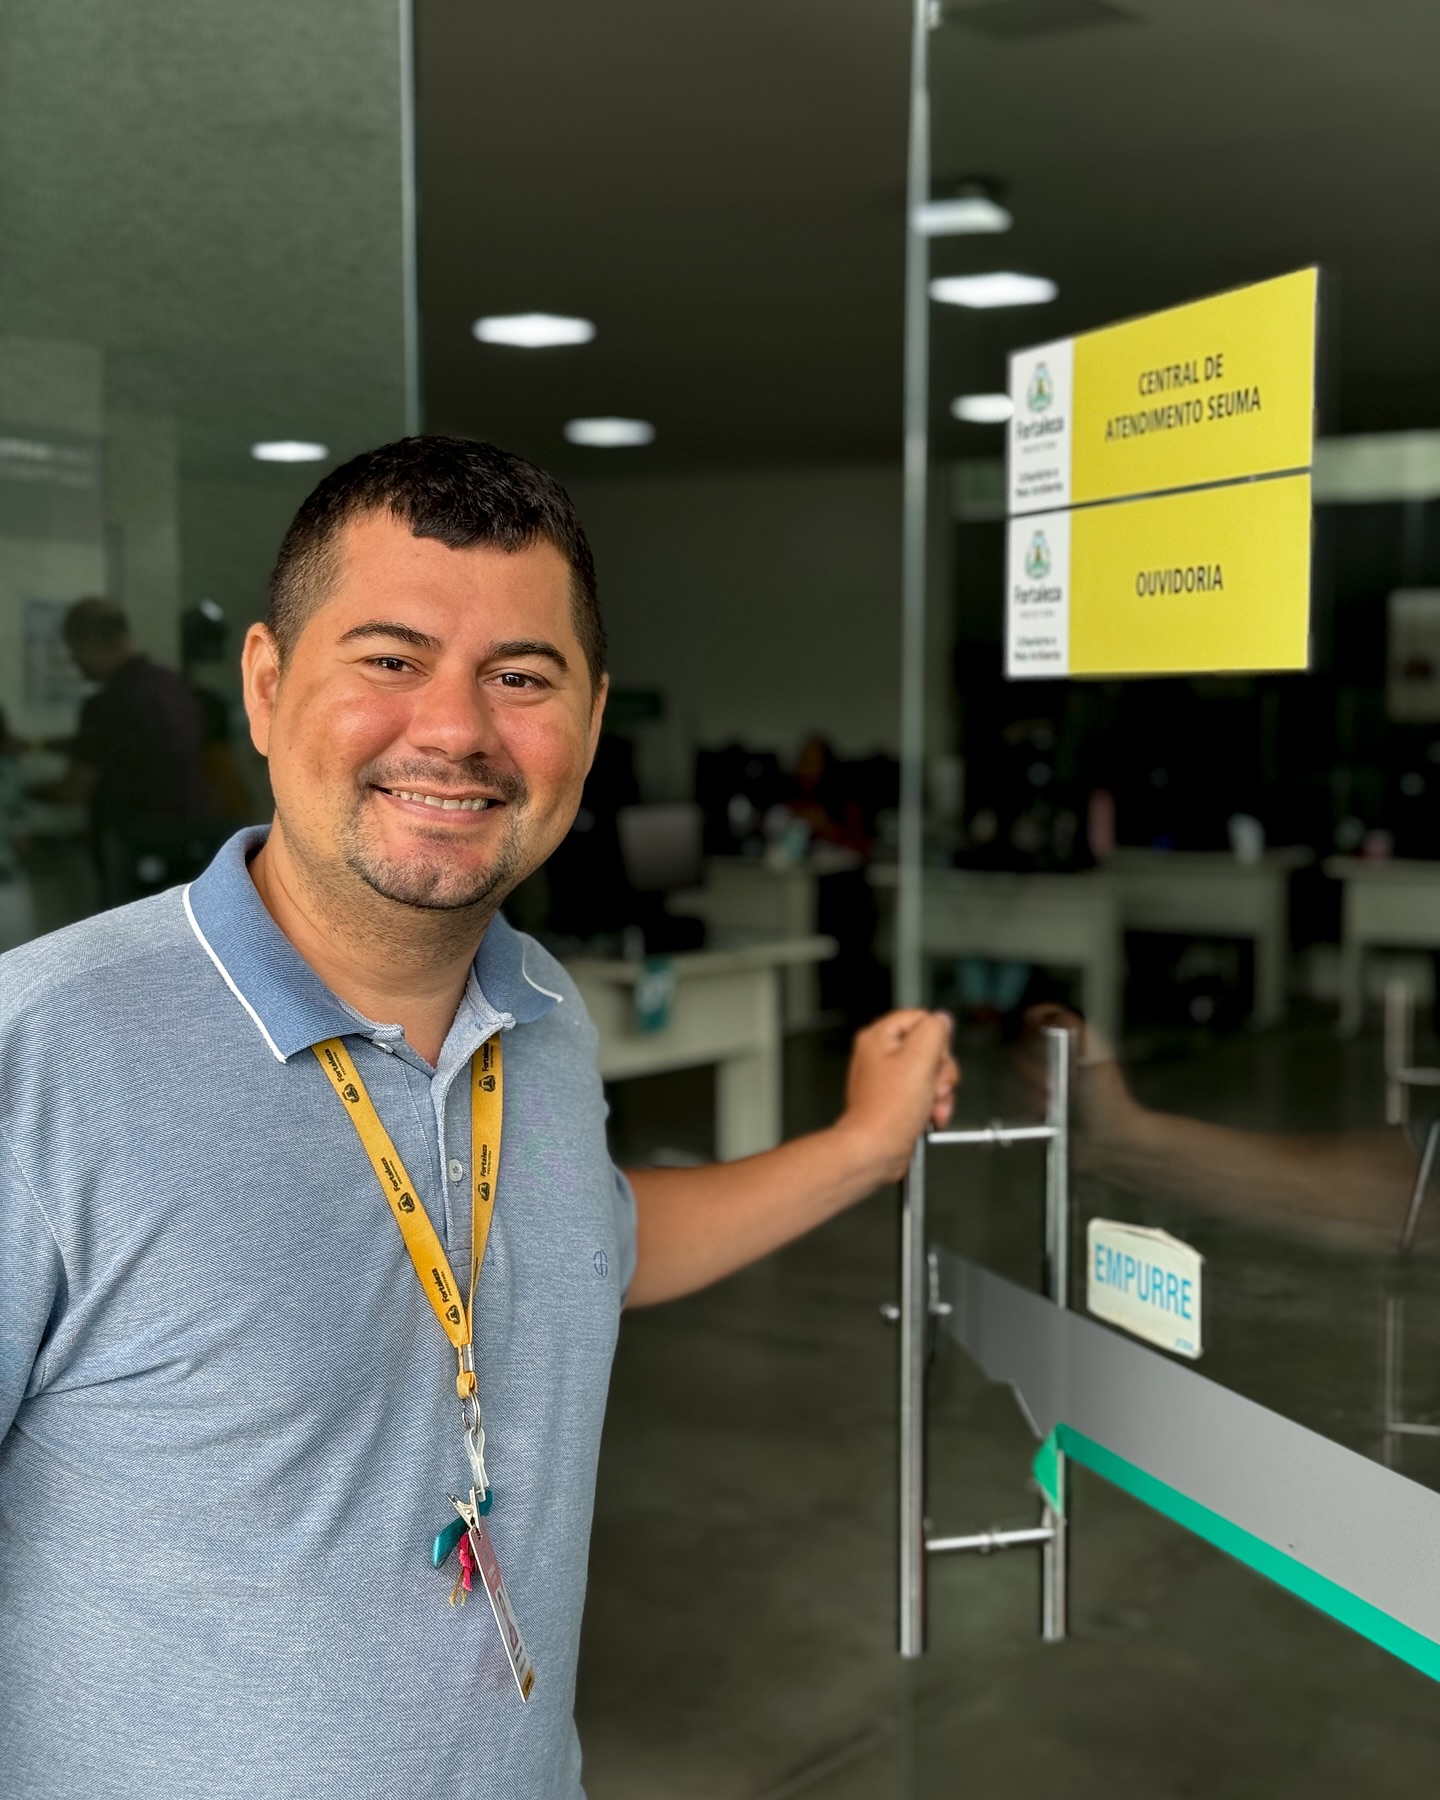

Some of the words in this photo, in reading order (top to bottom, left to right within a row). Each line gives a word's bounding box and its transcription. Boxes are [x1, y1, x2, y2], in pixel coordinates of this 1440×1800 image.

[1138, 360, 1199, 396] CENTRAL
[1204, 353, 1224, 381] DE
[1105, 399, 1203, 442] ATENDIMENTO
[1208, 386, 1261, 421] SEUMA
[1136, 564, 1224, 597] OUVIDORIA
[325, 1048, 345, 1082] Fortaleza
[482, 1042, 490, 1072] Fortaleza
[381, 1157, 401, 1192] Fortaleza
[480, 1144, 488, 1177] Fortaleza
[432, 1267, 450, 1303] Fortaleza
[1095, 1243, 1192, 1321] EMPURRE
